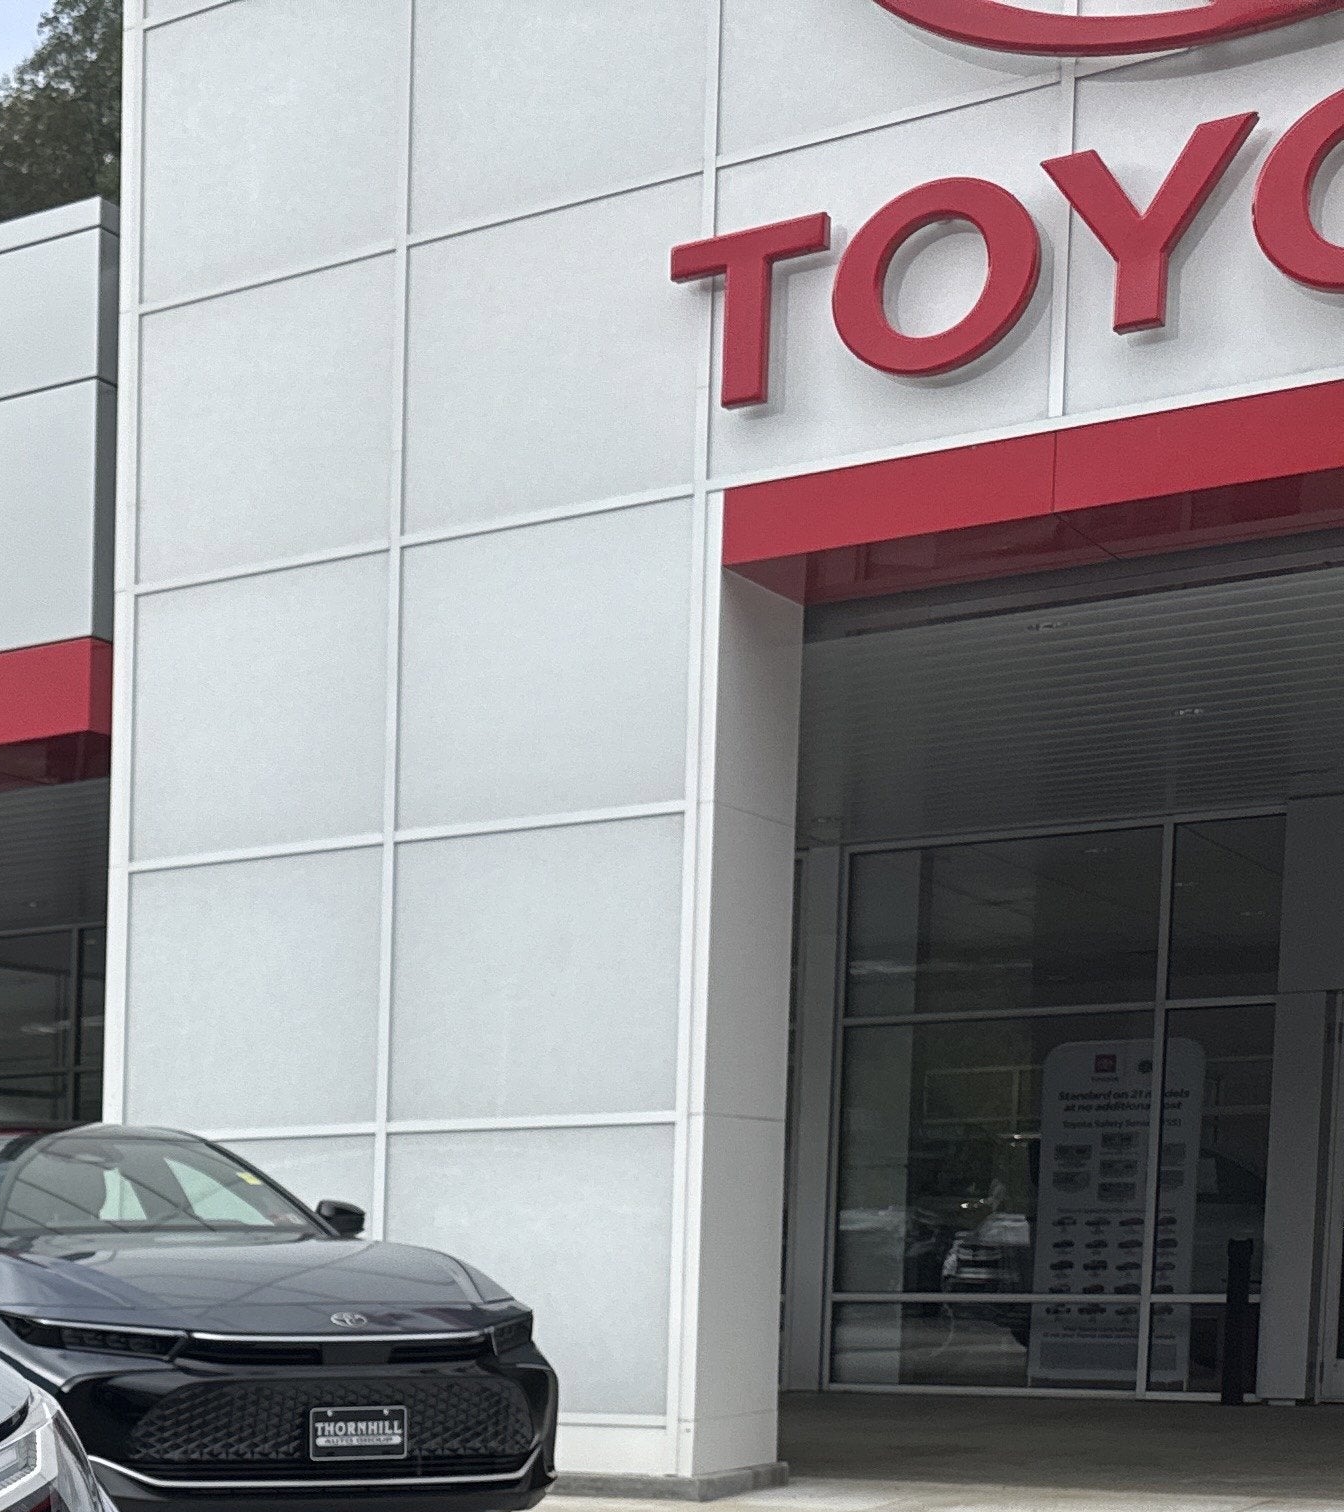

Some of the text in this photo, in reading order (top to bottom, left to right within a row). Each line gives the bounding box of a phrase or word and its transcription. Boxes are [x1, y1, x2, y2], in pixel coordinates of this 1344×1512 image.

[1144, 1088, 1190, 1099] mdels
[1095, 1102, 1151, 1111] additiona
[1125, 1119, 1150, 1127] Sens
[314, 1419, 403, 1436] THORNHILL
